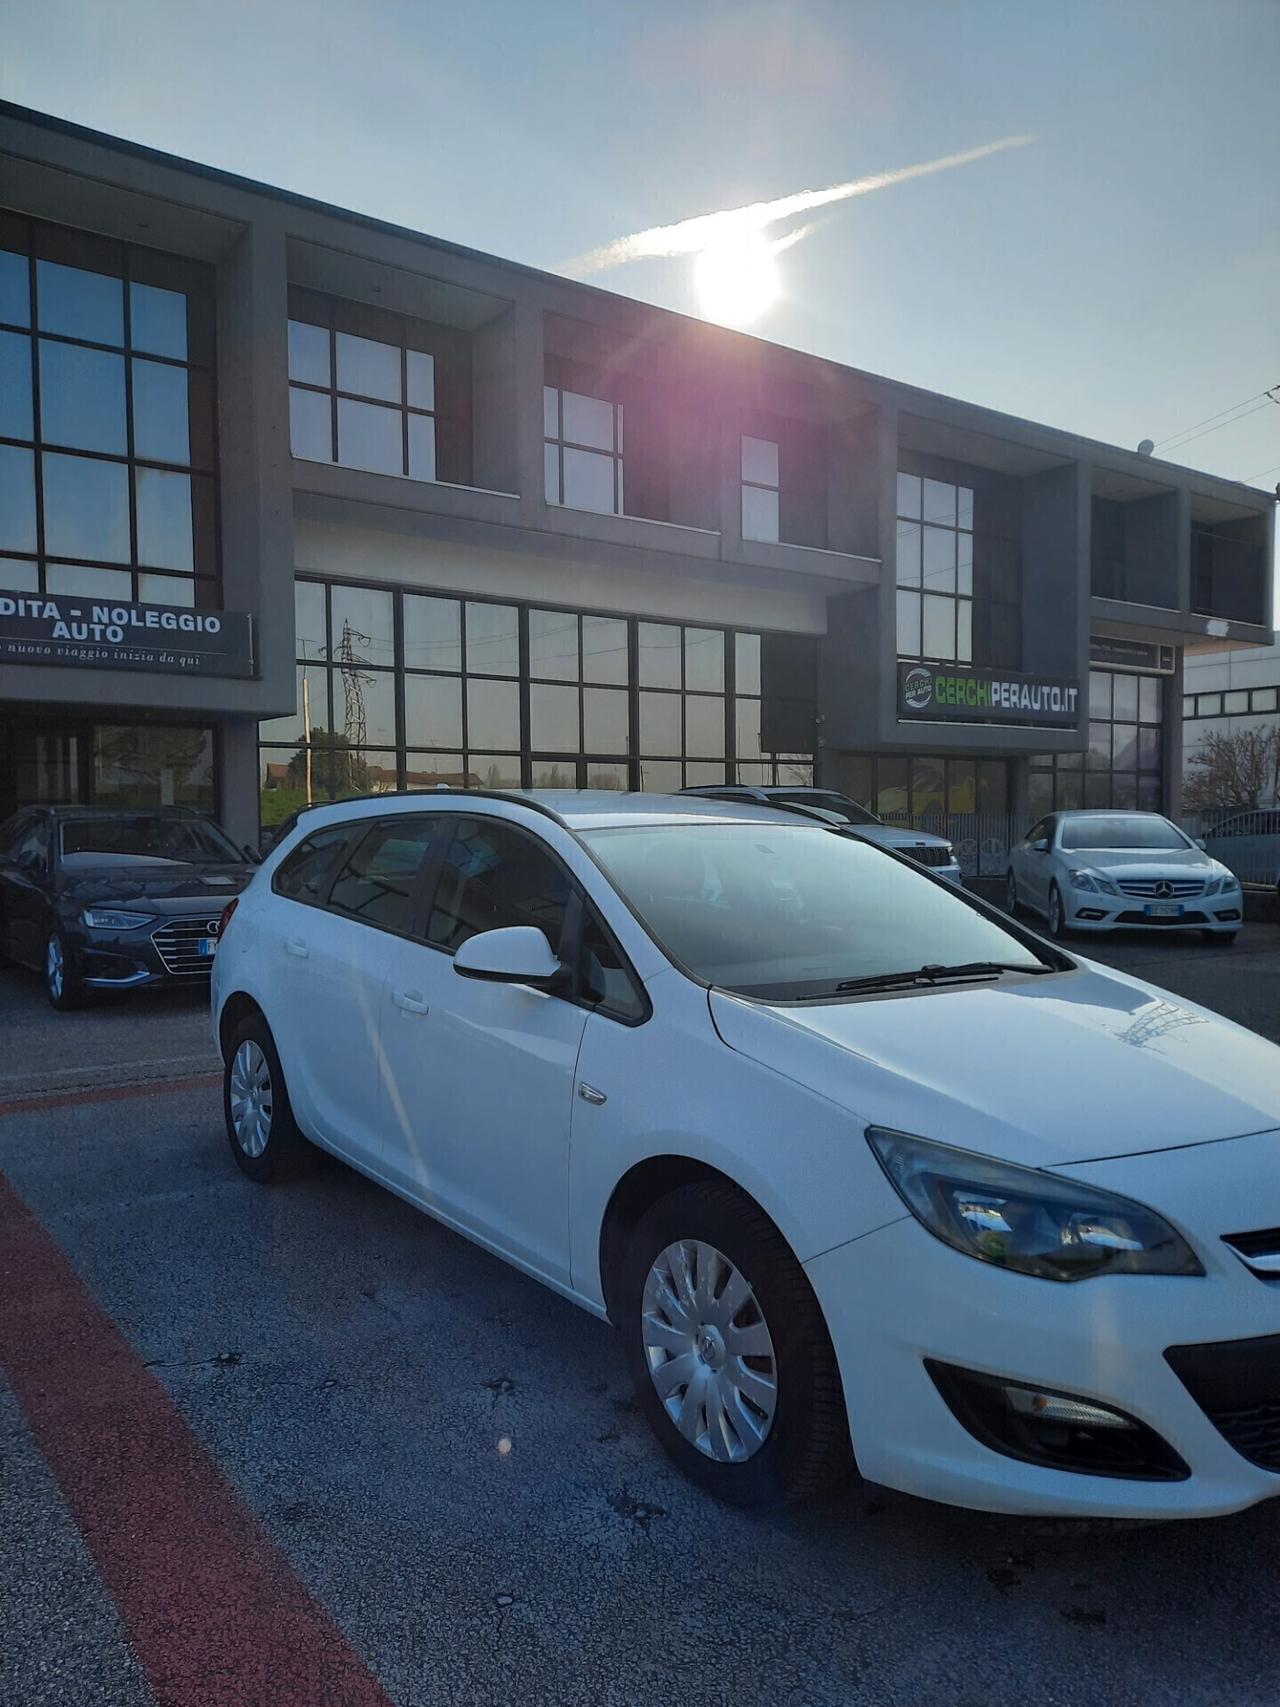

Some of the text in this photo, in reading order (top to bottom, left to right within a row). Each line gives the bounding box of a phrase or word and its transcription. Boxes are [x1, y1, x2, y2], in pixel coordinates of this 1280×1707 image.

[92, 605, 221, 634] NOLEGGIO
[52, 620, 123, 643] AUTO
[8, 644, 51, 655] nuovo
[57, 645, 108, 661] viaggio
[114, 648, 154, 662] inizia
[159, 651, 176, 663] da
